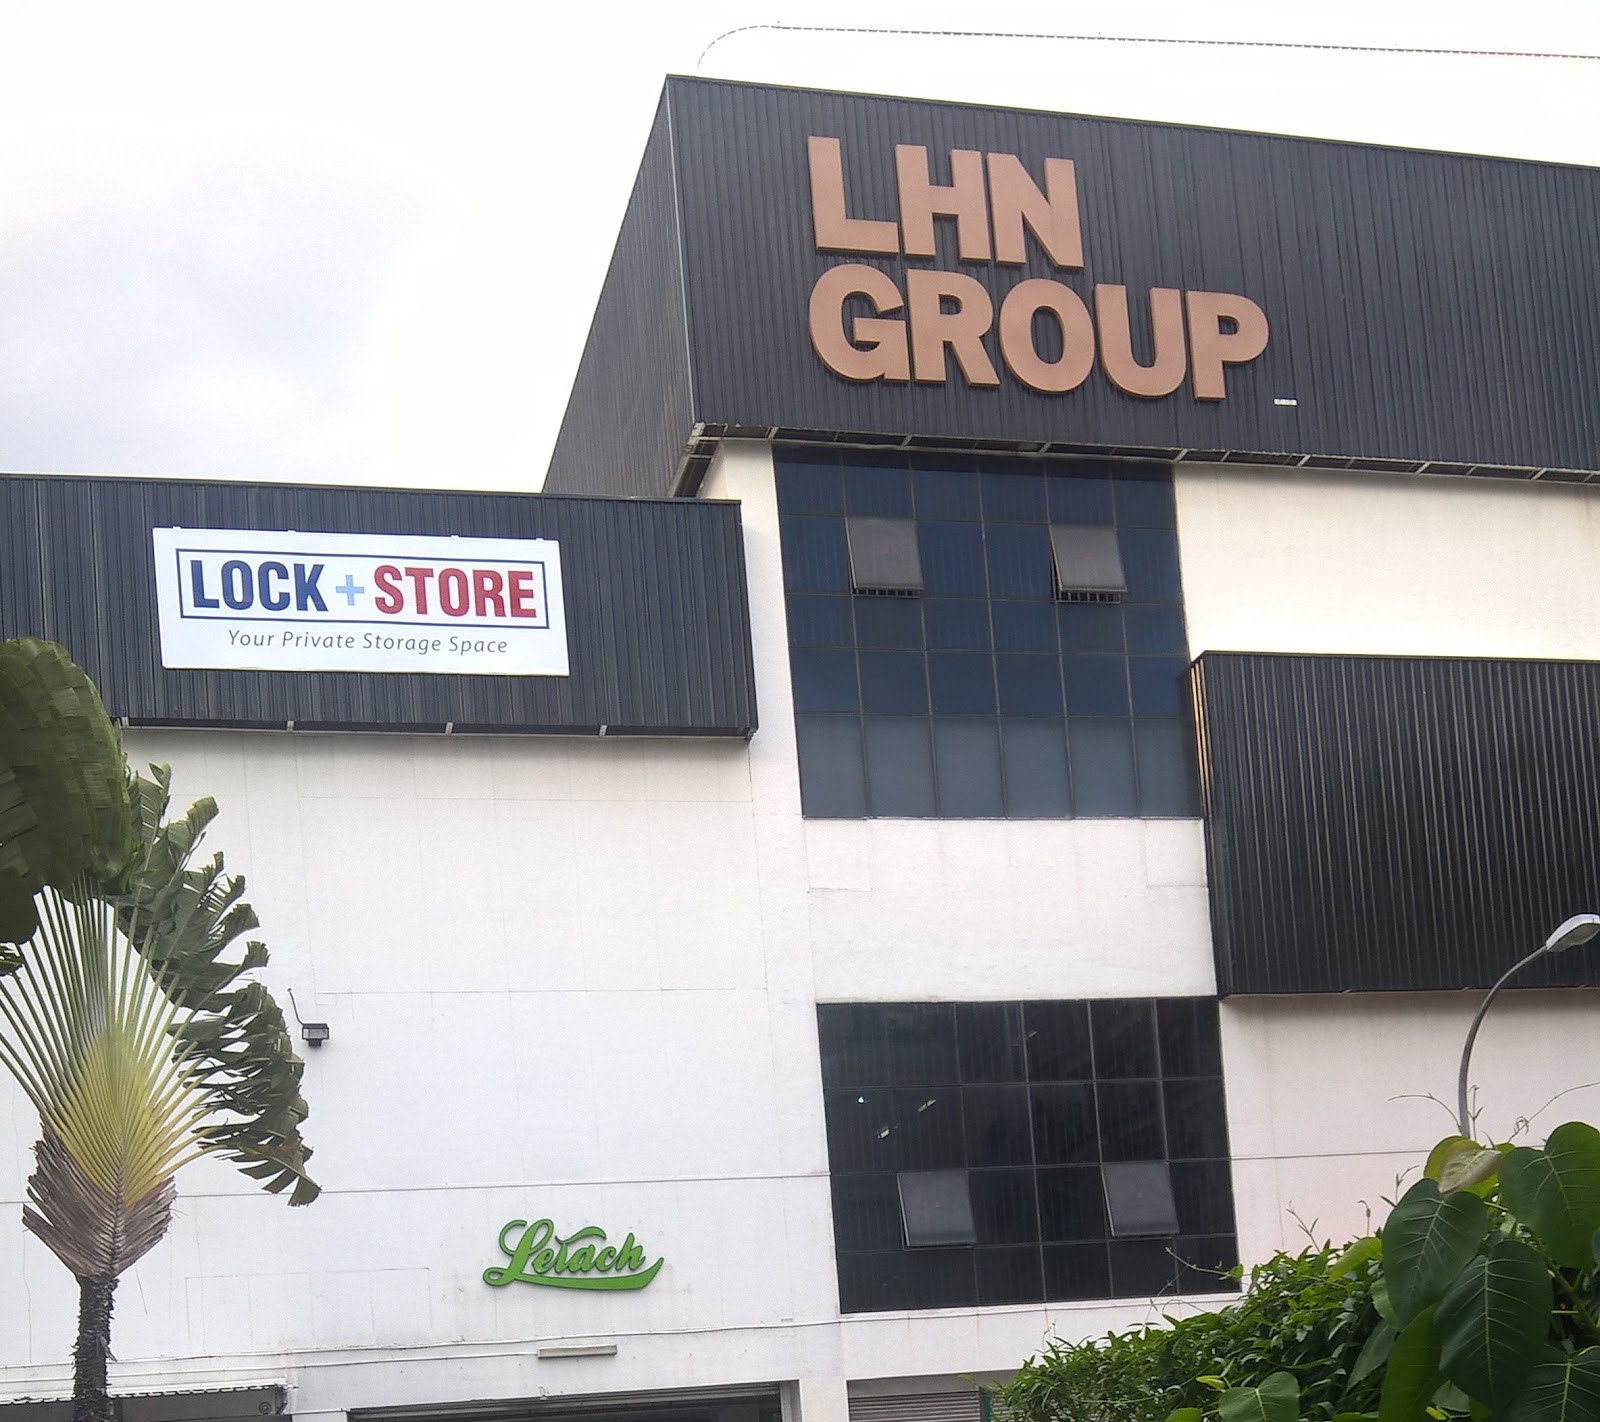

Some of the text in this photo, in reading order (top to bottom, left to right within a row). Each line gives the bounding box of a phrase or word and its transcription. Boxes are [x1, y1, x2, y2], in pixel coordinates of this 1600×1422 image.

[808, 136, 1084, 269] LHN
[808, 263, 1270, 401] GROUP
[189, 560, 329, 613] LOCK
[374, 564, 538, 618] STORE
[228, 629, 508, 656] Your Private Storage Space
